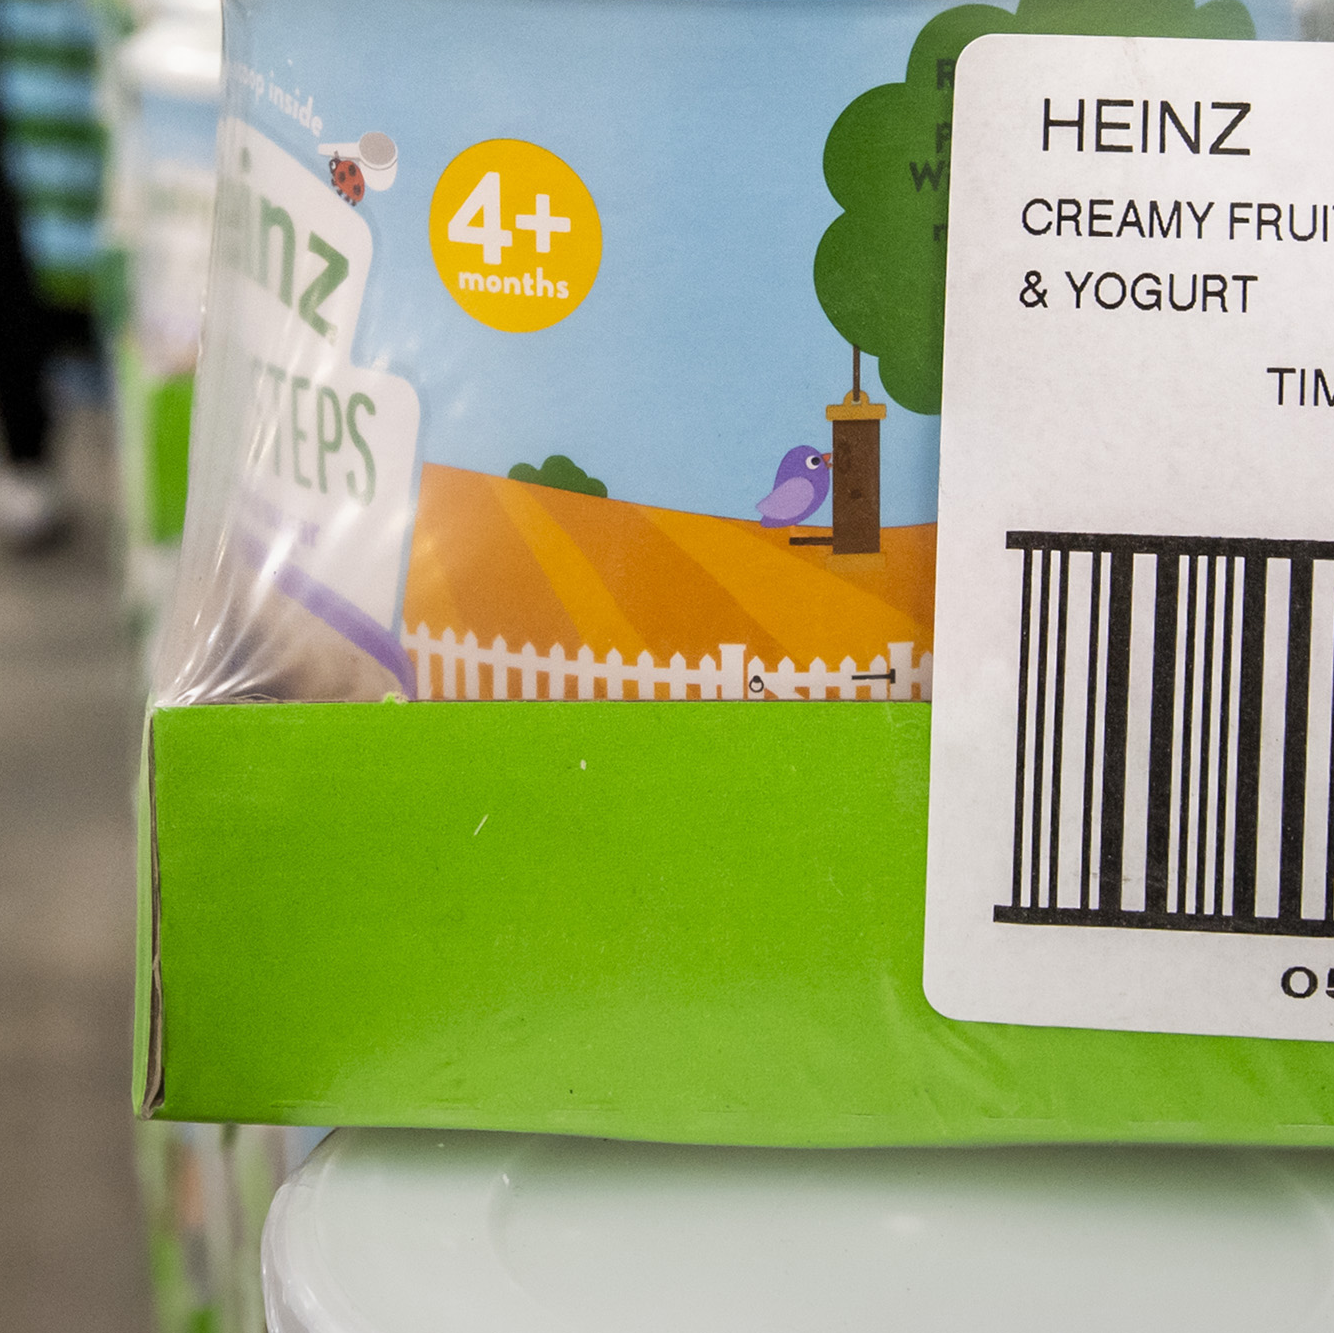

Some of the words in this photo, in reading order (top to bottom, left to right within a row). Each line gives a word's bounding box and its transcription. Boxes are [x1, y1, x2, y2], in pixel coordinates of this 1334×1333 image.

[267, 71, 324, 137] inside
[1042, 98, 1251, 156] HEINZ
[448, 171, 571, 265] 4+
[1021, 198, 1213, 240] CREAMY
[458, 268, 570, 300] months
[1019, 271, 1049, 309] &
[1065, 272, 1258, 313] YOGURT
[253, 360, 377, 507] TEPS
